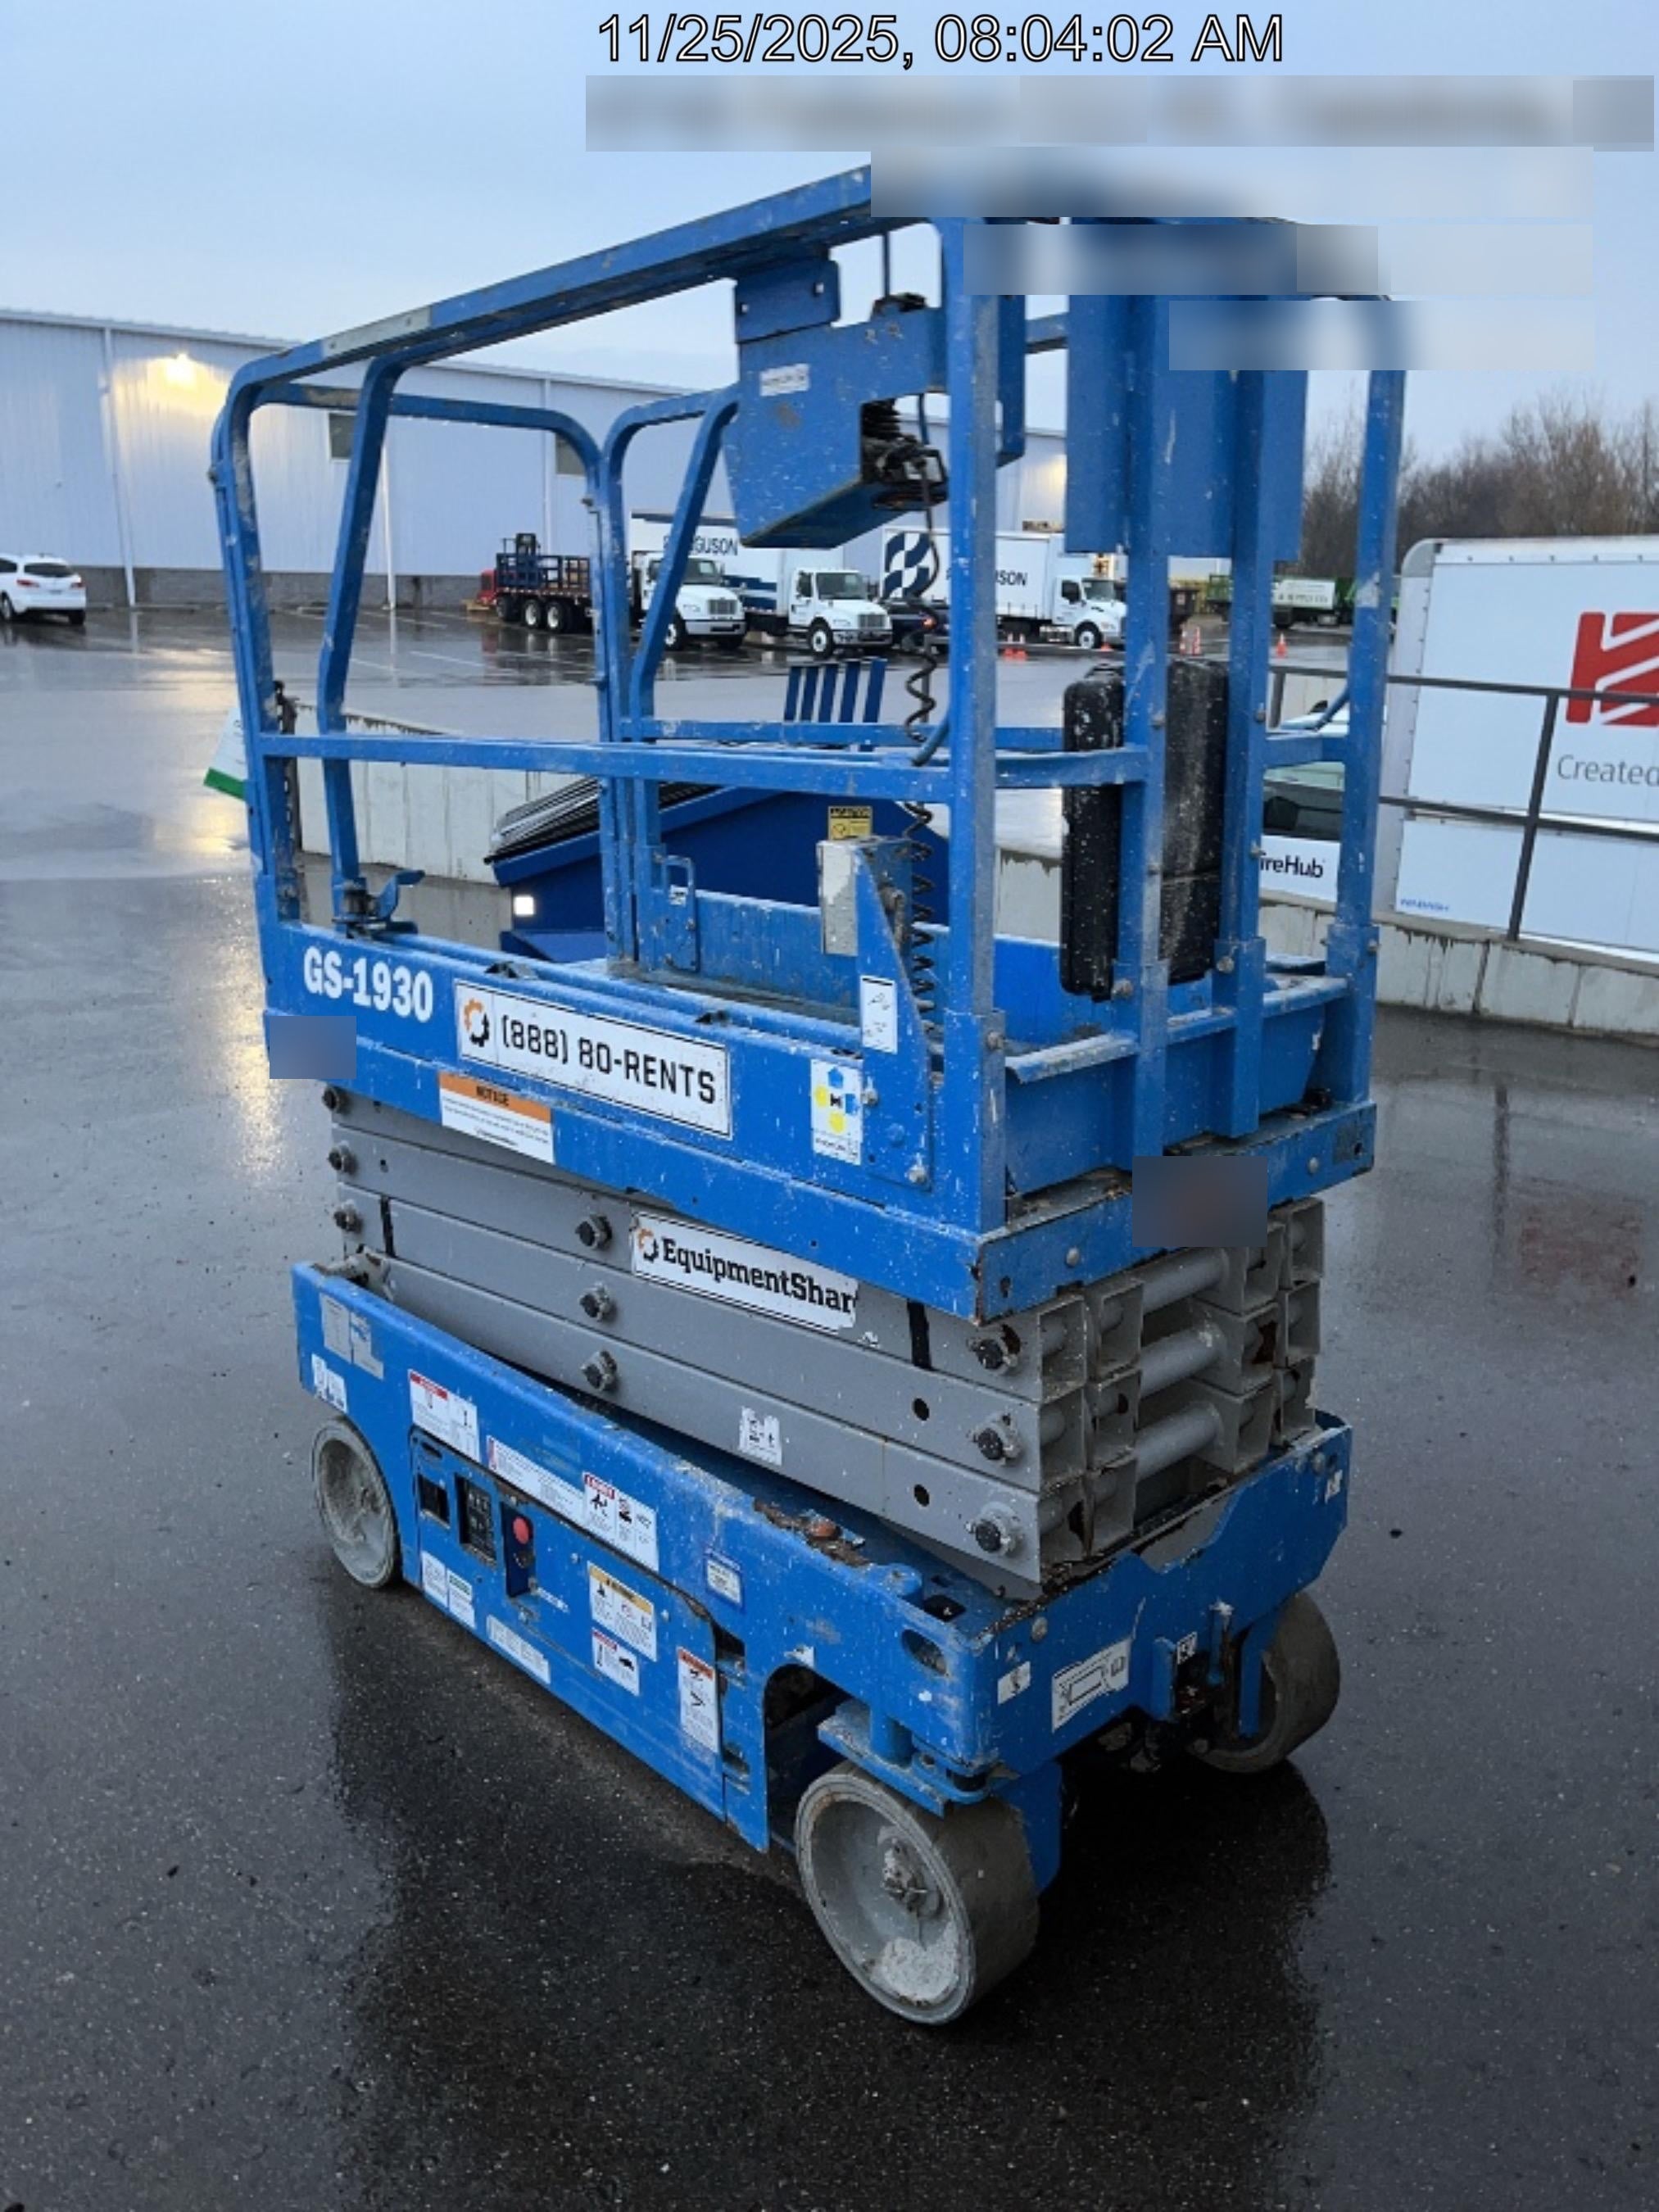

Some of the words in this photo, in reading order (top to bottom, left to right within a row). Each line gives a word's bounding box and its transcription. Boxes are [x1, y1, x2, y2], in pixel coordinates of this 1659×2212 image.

[304, 945, 433, 1023] GS-1930
[501, 1014, 569, 1064] (888)
[578, 1037, 716, 1104] 80-RENTS
[662, 1236, 859, 1314] EquipmentShar
